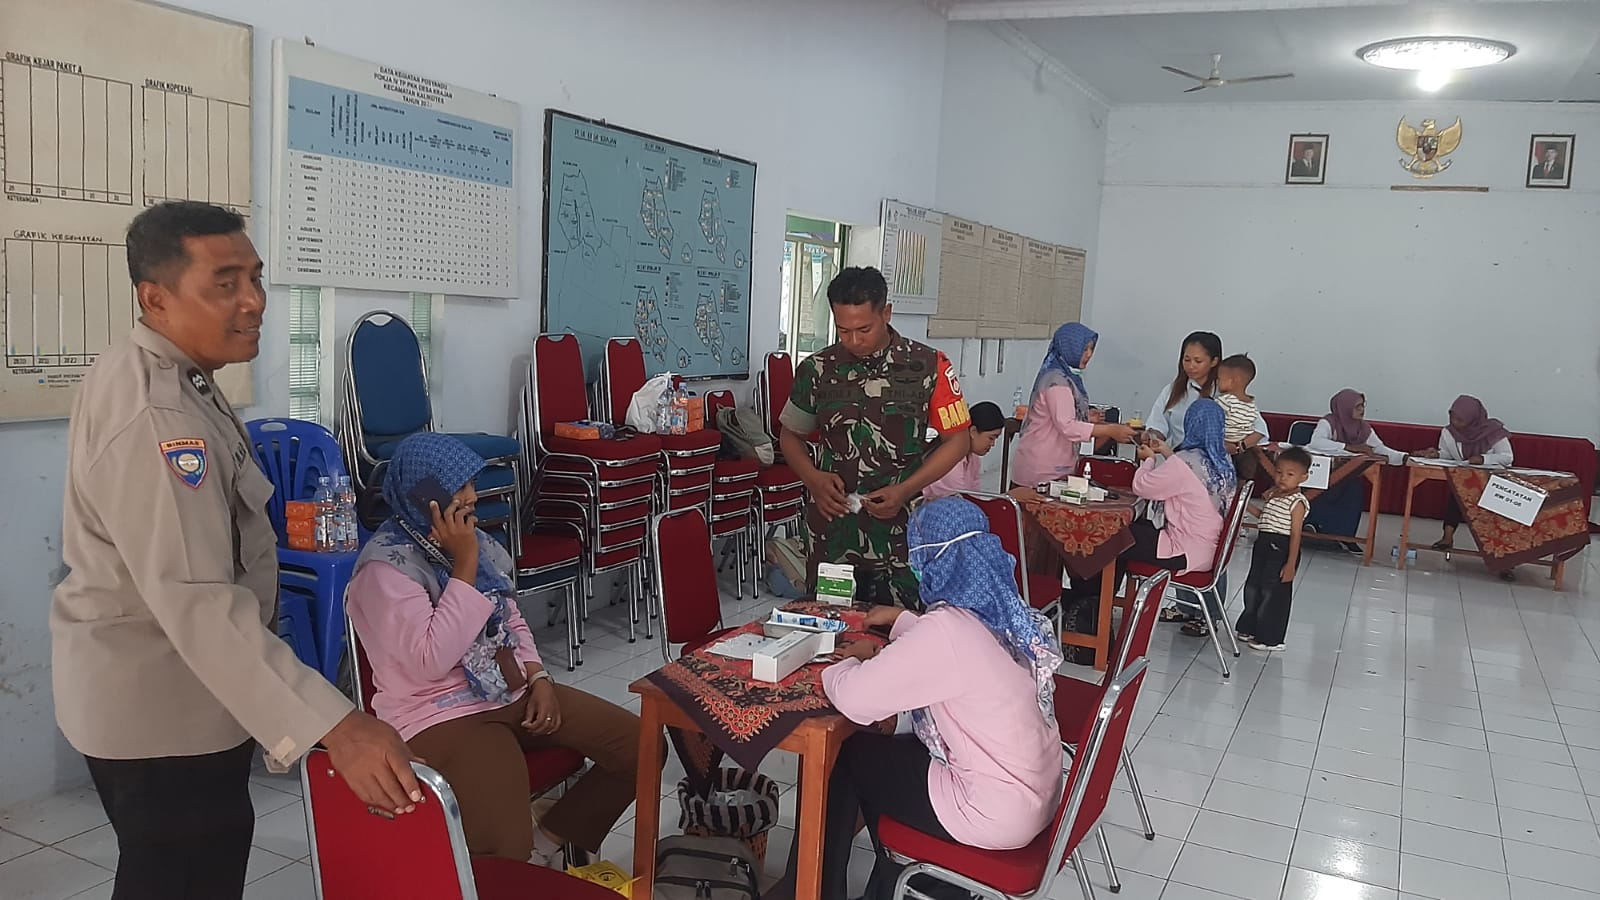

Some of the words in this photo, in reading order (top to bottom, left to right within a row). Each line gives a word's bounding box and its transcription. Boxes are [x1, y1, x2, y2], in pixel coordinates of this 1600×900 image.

[5, 51, 32, 63] GRAFIK
[57, 61, 77, 73] PAKET
[145, 78, 165, 89] GRAFIK
[166, 83, 193, 94] KOPERASI
[383, 84, 415, 97] KECAMATAN
[14, 229, 48, 240] GRAFIK
[166, 440, 200, 448] BINMAS
[1491, 482, 1532, 502] PENCATATAN
